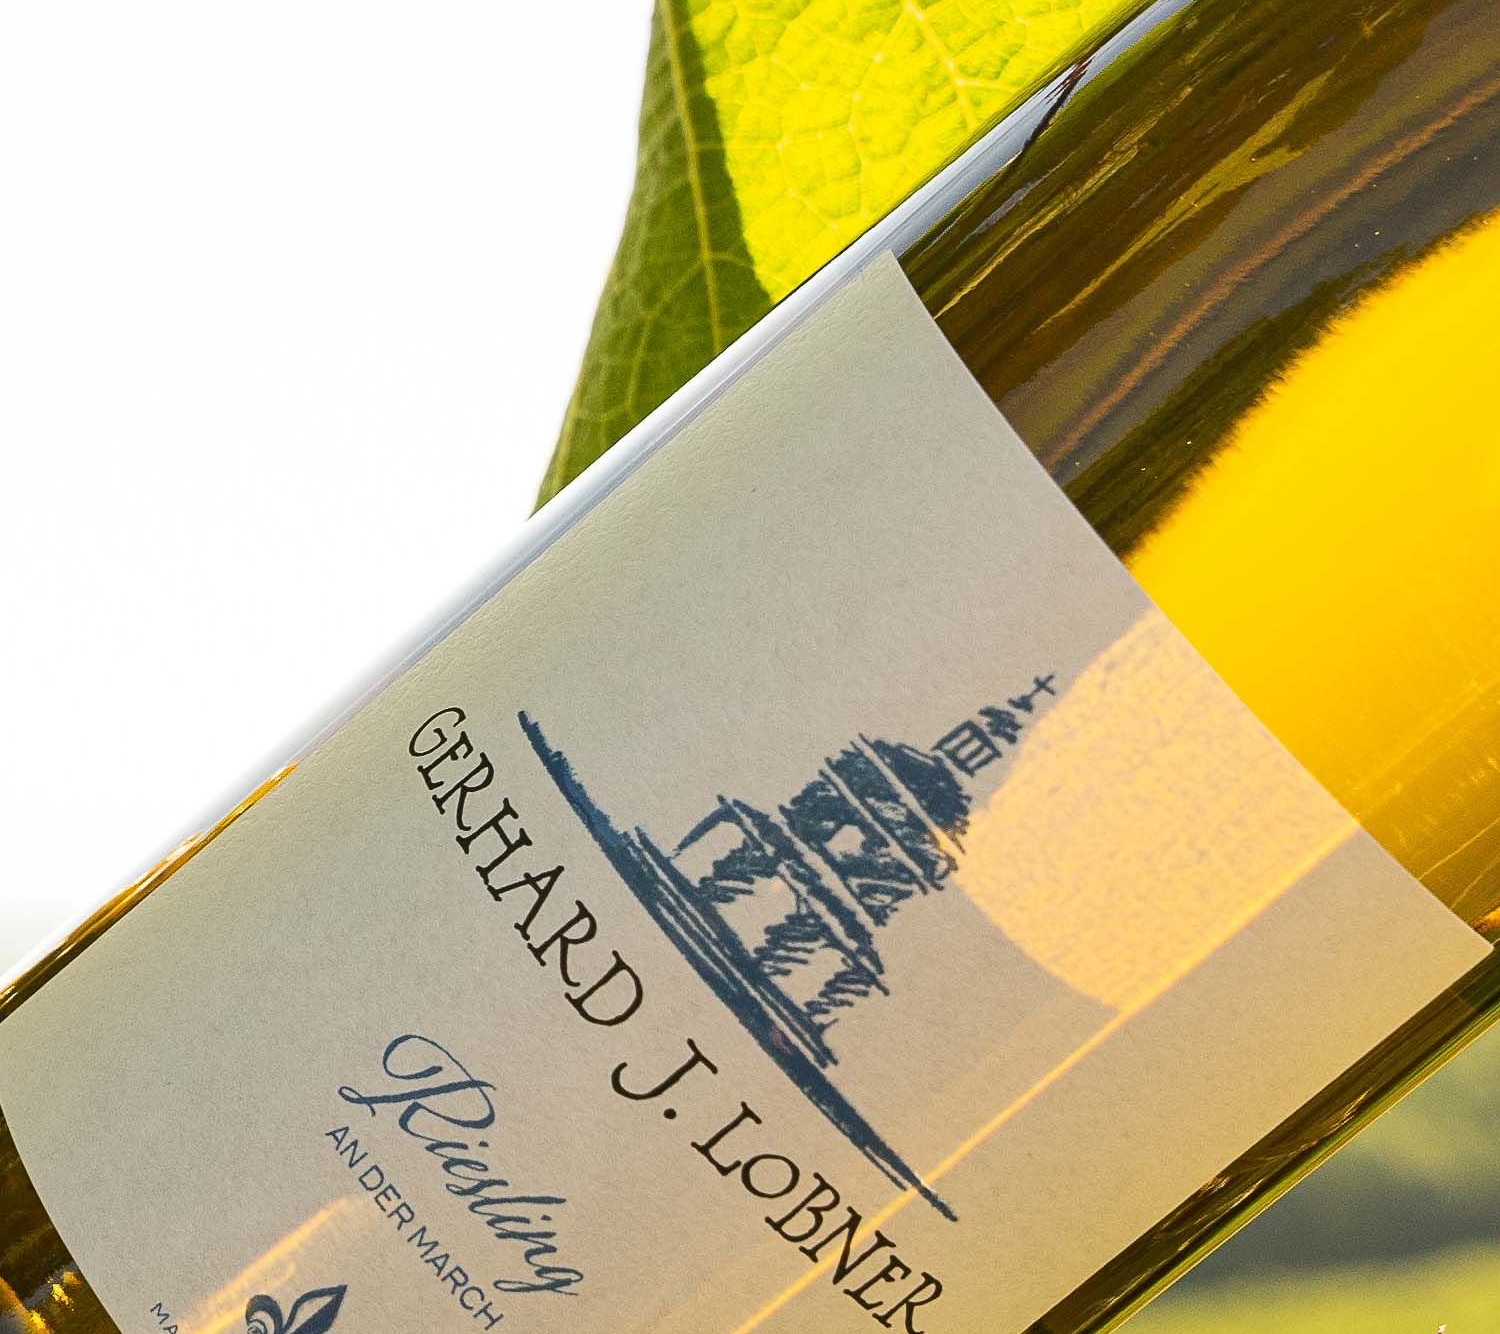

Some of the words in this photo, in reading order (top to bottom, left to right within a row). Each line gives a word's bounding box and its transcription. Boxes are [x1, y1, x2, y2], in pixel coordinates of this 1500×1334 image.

[408, 706, 644, 1027] GERHARD
[611, 1037, 719, 1120] J.
[324, 1125, 369, 1169] AN
[358, 1164, 416, 1231] DER
[407, 1226, 505, 1331] MARCH
[337, 1034, 585, 1296] Riesling
